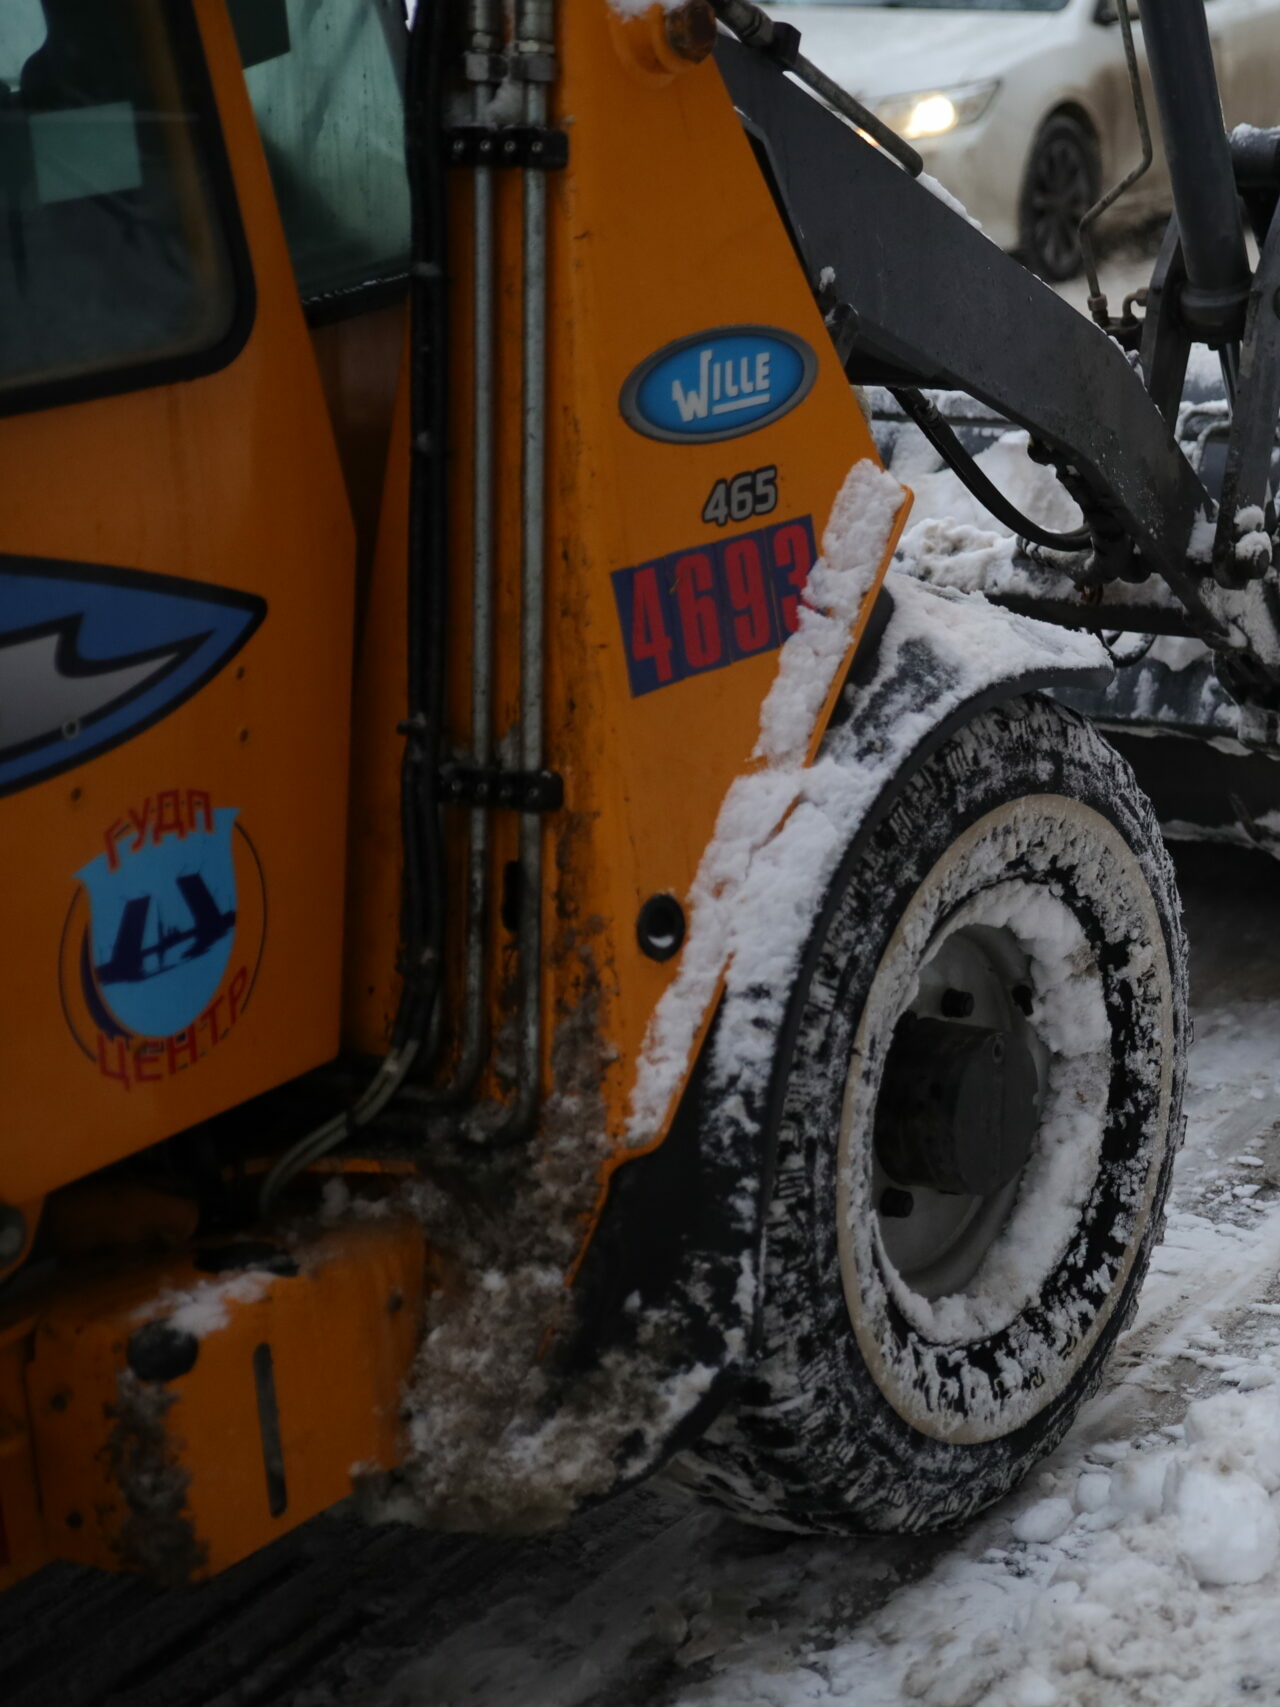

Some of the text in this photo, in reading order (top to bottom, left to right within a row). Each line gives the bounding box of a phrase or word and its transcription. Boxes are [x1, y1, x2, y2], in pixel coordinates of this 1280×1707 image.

[703, 465, 778, 526] 465
[631, 524, 812, 683] 4693
[104, 789, 214, 873] ГУДП
[98, 966, 248, 1091] ЦЕНТР
